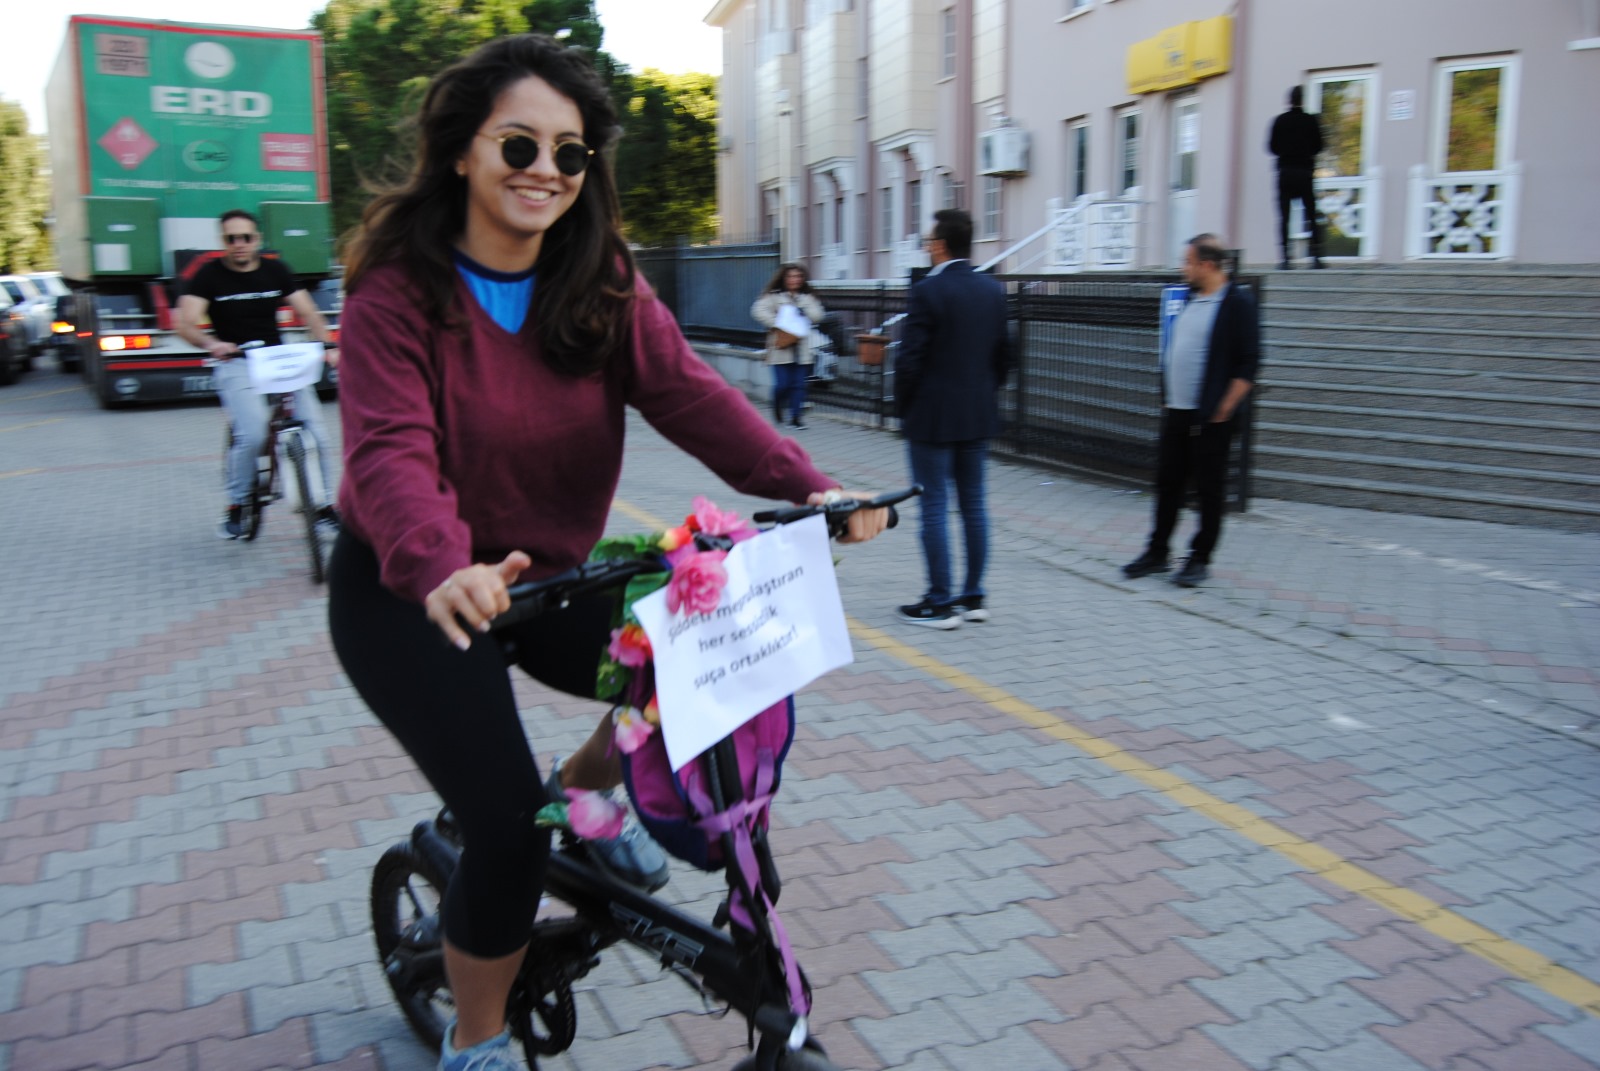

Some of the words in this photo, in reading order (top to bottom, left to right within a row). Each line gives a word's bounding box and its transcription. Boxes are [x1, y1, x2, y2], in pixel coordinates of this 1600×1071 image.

[150, 85, 273, 118] ERD
[698, 633, 725, 653] her
[693, 665, 726, 690] suça
